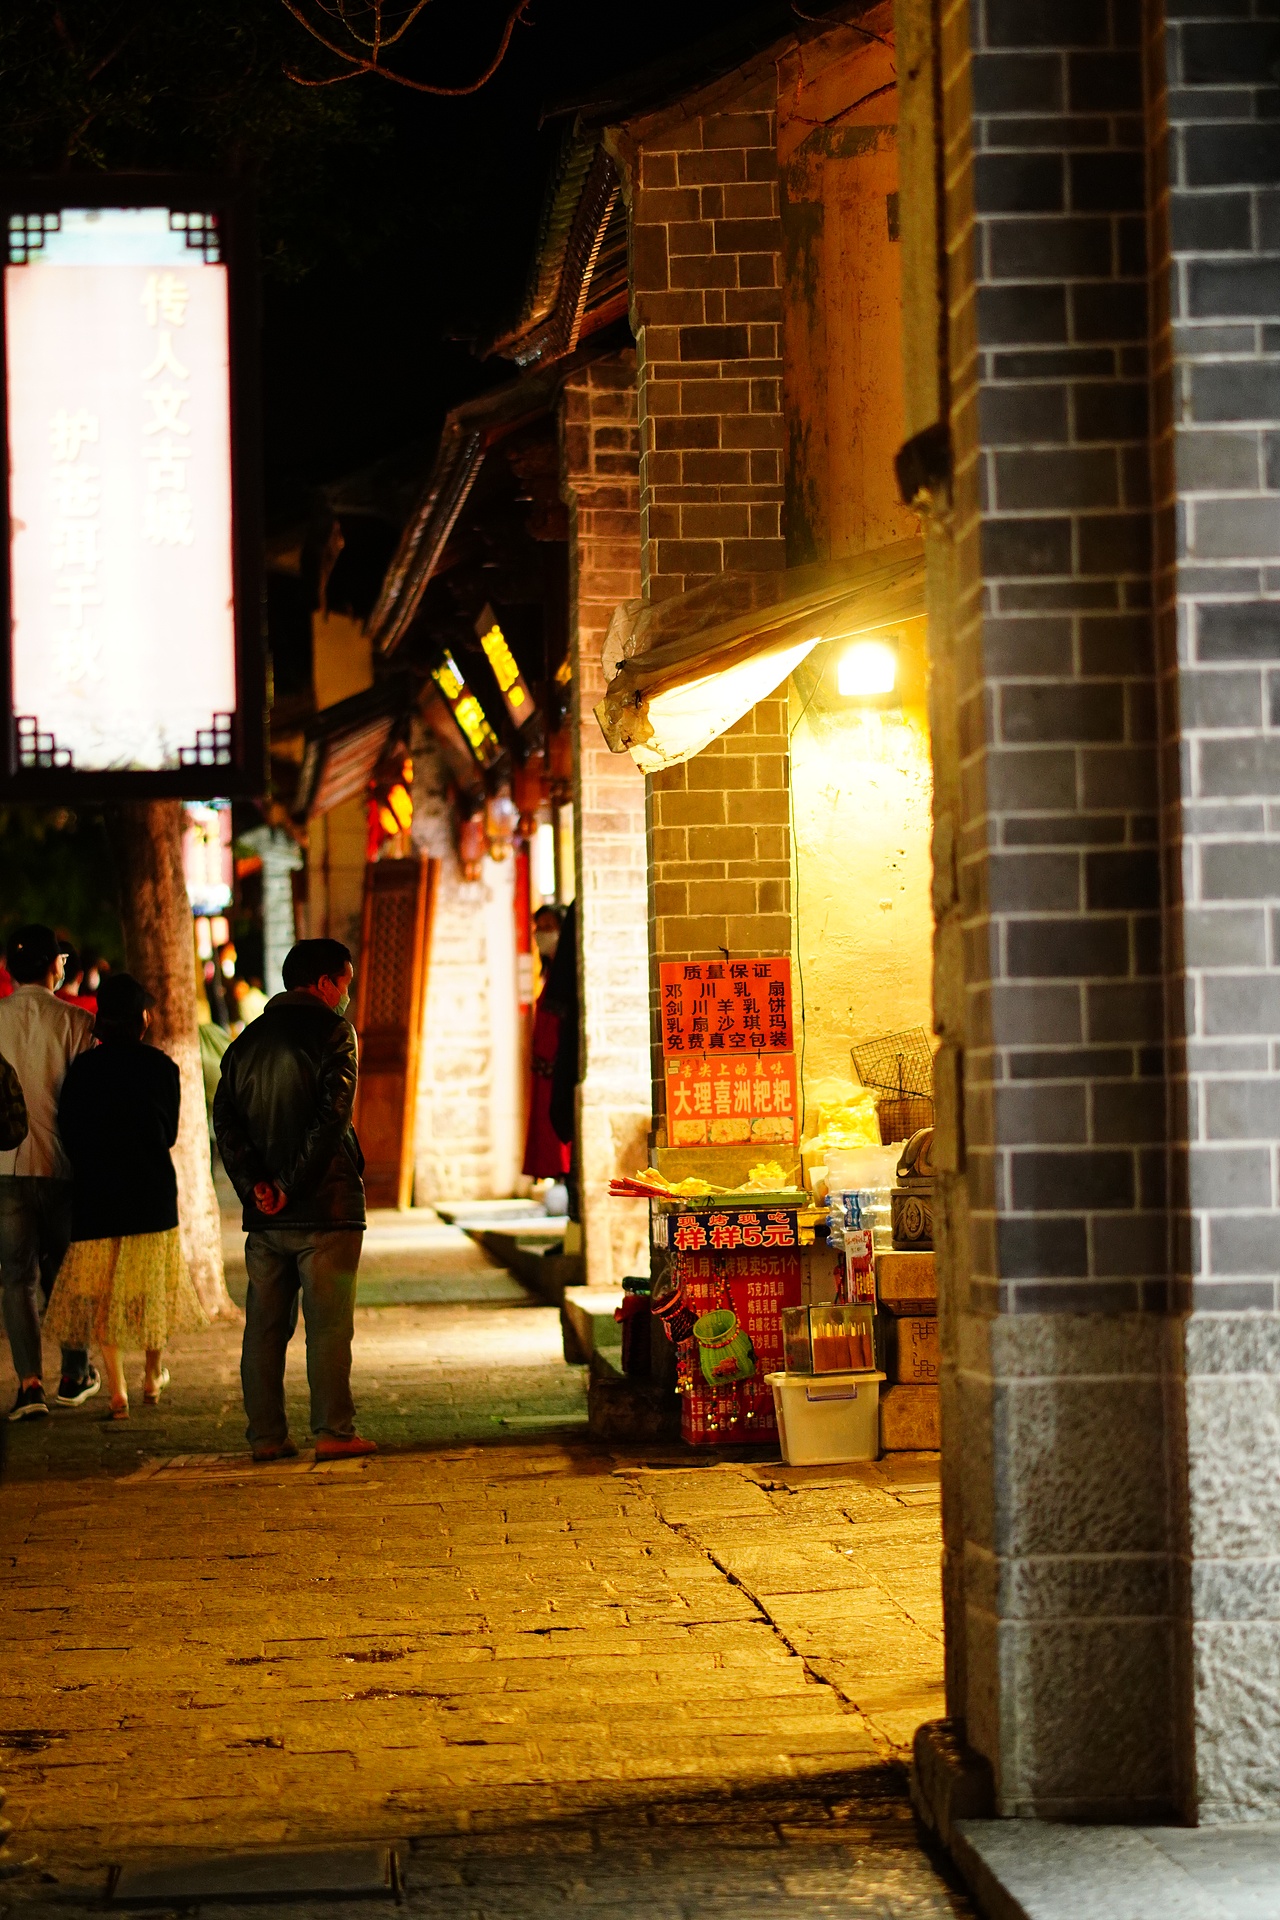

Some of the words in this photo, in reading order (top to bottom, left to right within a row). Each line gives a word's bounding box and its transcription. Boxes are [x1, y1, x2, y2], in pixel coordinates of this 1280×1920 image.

[683, 963, 772, 980] 质量保证
[665, 981, 785, 999] 邓川乳扇
[665, 997, 786, 1016] 剑川羊乳饼
[666, 1015, 787, 1033] 乳扇沙琪玛
[667, 1031, 787, 1050] 免费真空包装
[681, 1060, 785, 1078] 舌尖上的美味
[673, 1078, 792, 1116] 大理喜洲粑粑
[677, 1212, 789, 1227] 现烤现吃
[674, 1224, 795, 1251] 样样5元
[747, 1281, 784, 1297] 巧克力乳扇
